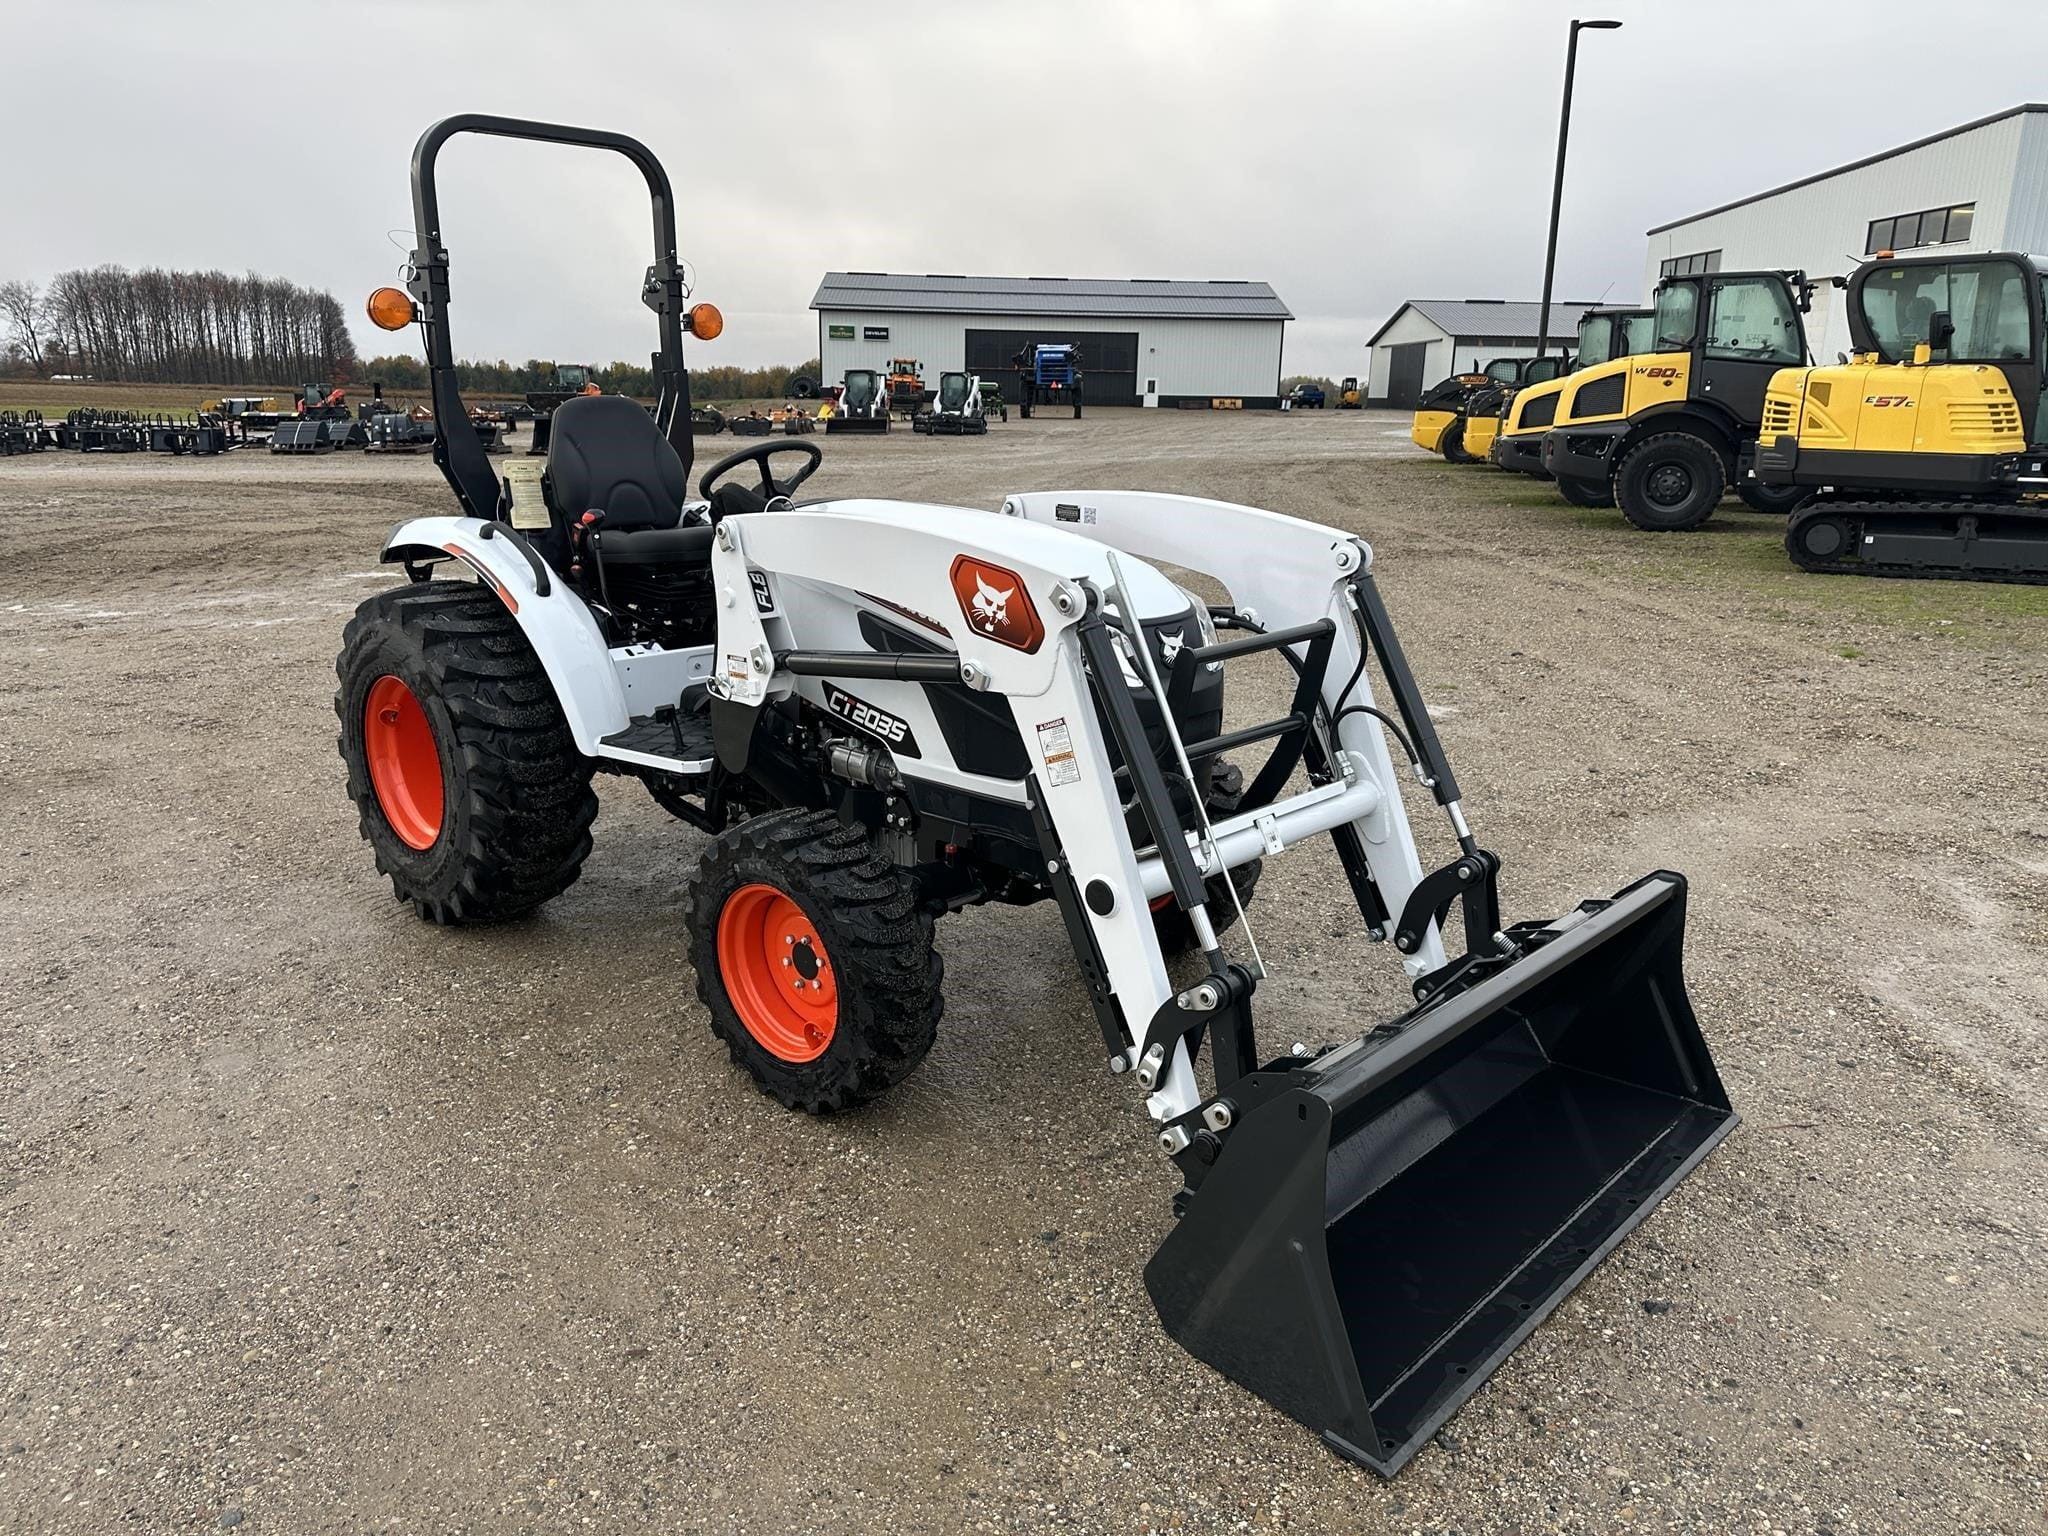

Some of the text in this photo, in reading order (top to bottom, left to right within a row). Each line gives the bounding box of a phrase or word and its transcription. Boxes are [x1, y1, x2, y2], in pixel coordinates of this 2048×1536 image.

[749, 572, 772, 608] FL8
[829, 690, 908, 743] CT2035
[1043, 720, 1064, 729] DANGER
